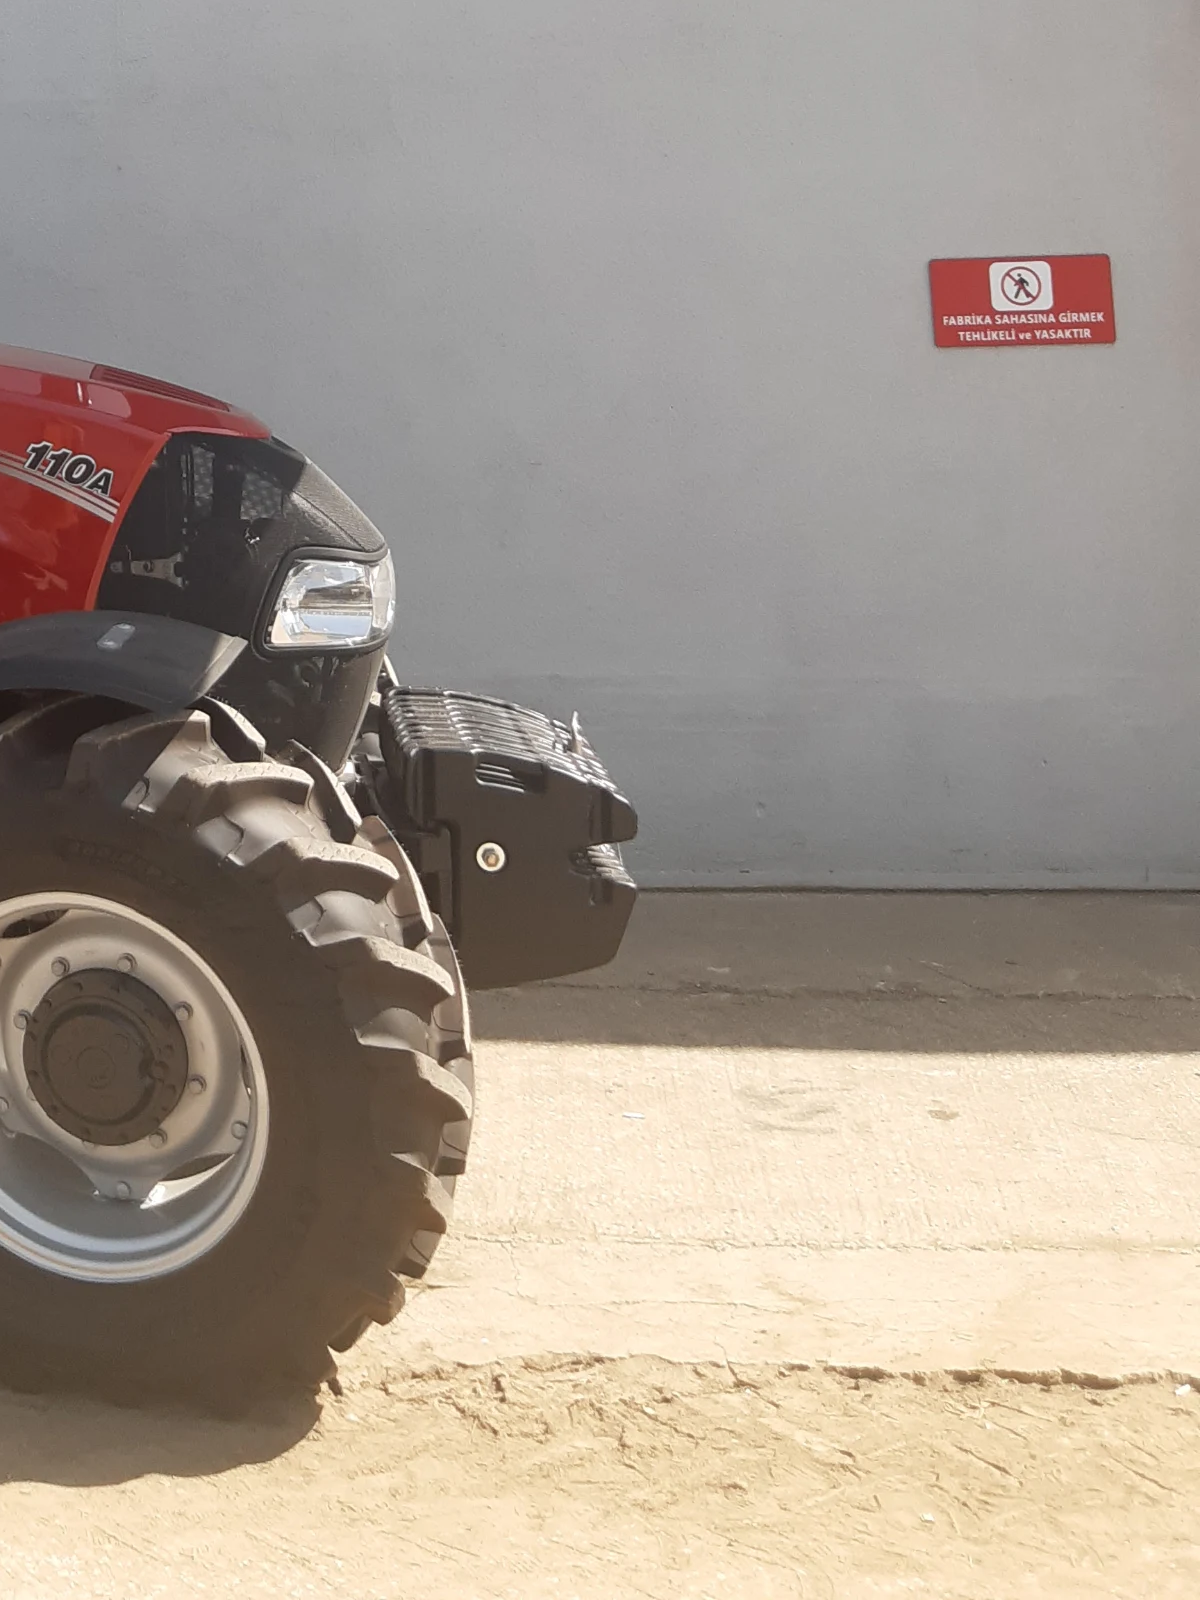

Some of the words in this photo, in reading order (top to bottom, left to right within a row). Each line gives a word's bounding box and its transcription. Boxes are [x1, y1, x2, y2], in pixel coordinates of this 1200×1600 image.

[943, 313, 992, 326] FABRİKA
[995, 314, 1056, 325] SAHASINA
[1058, 311, 1105, 324] GİRMEK
[958, 329, 1016, 342] TEHLİKELİ
[1019, 332, 1032, 340] ve
[1034, 328, 1092, 340] YASAKTIR
[24, 441, 115, 497] 110A
